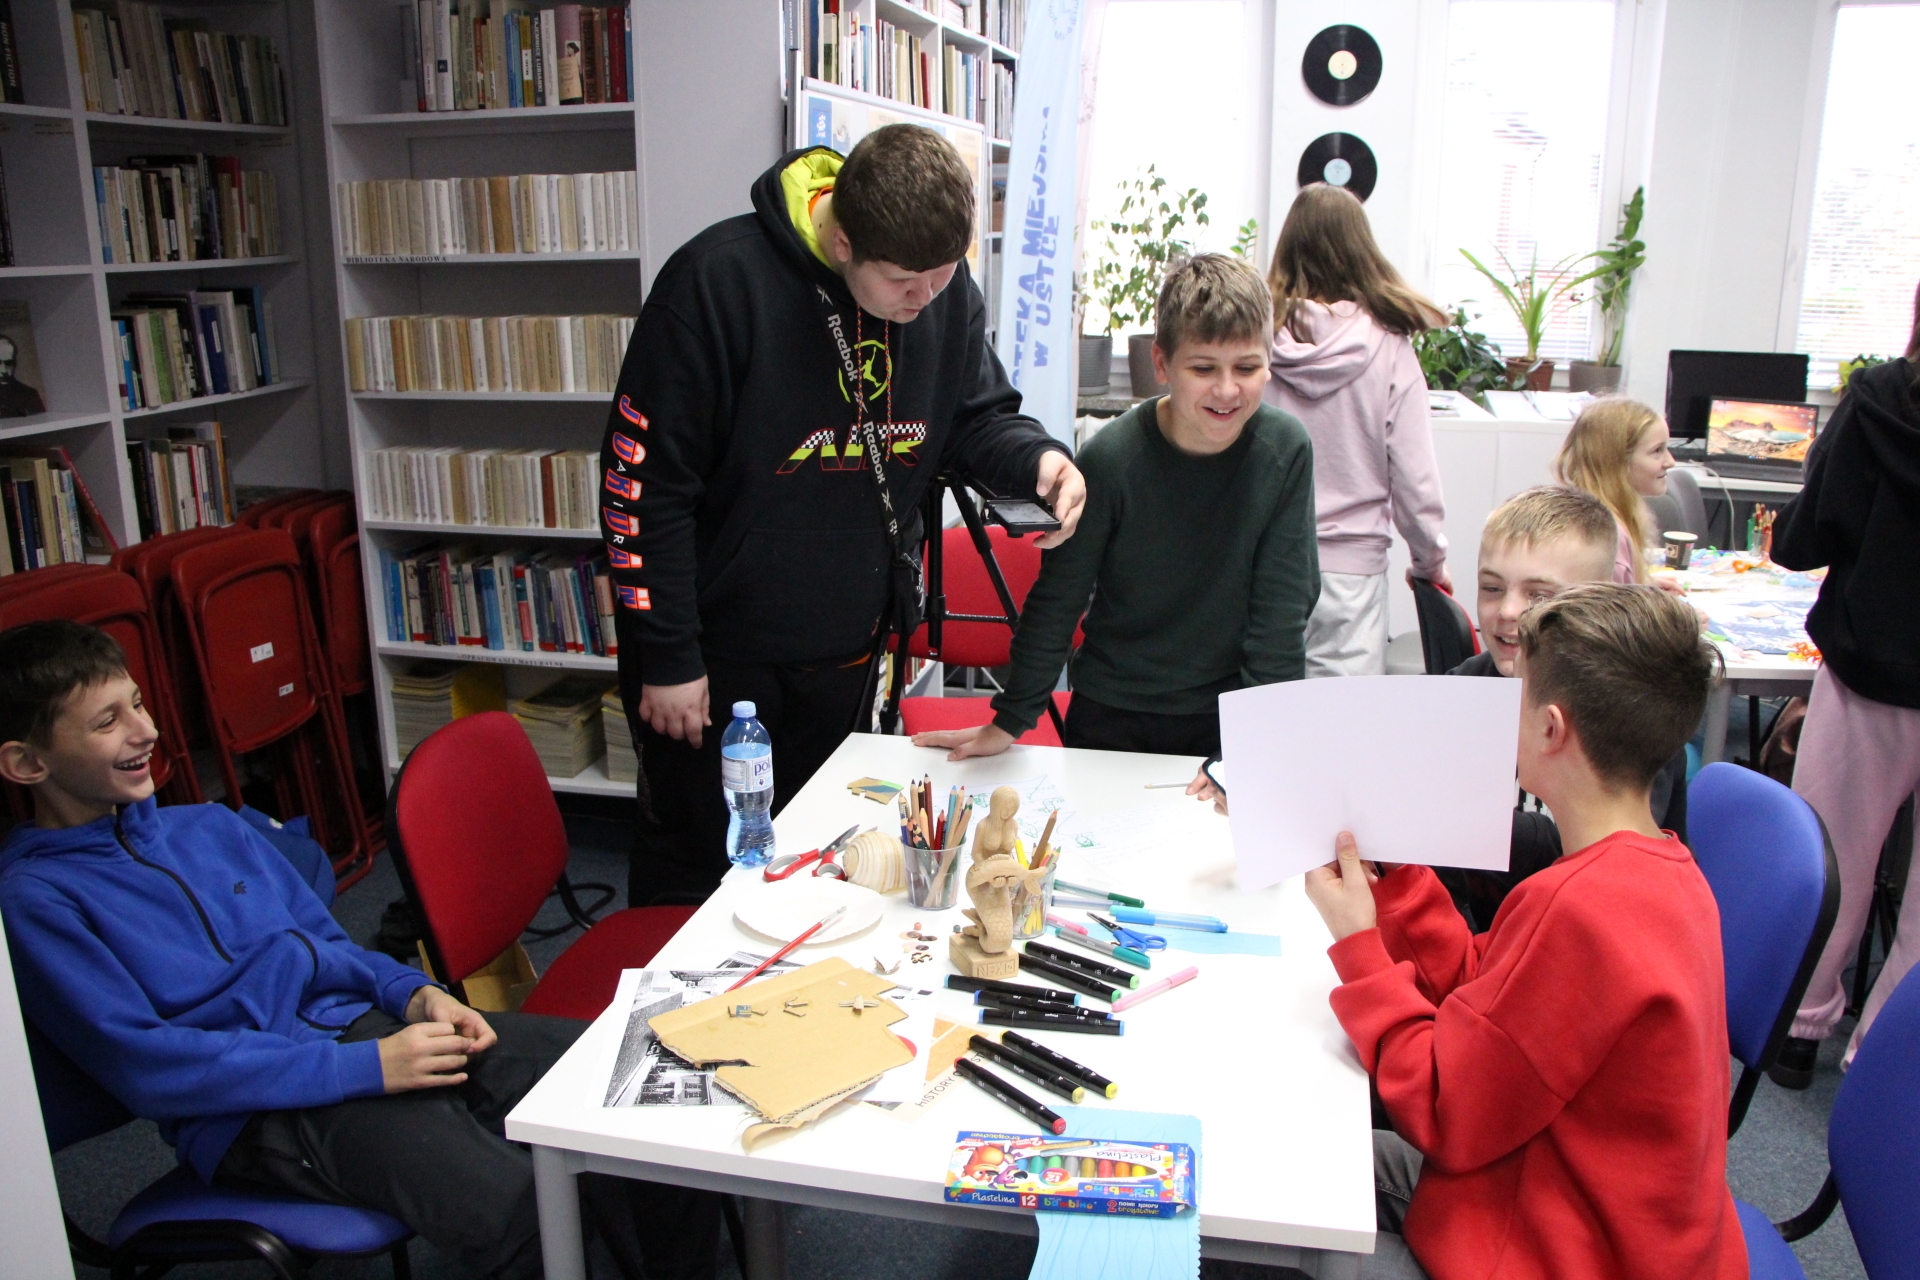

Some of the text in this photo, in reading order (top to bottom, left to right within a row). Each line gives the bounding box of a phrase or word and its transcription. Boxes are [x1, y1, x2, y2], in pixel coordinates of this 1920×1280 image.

[533, 16, 543, 93] TAJEMNICE LUBIANKI
[345, 255, 447, 264] BIBLIOTEKA NARODOWA
[827, 313, 859, 382] Reebok
[1033, 340, 1049, 367] W
[862, 420, 886, 484] Reebok
[603, 395, 651, 610] JORDAN
[914, 1076, 955, 1107] HISTORY
[1096, 1151, 1162, 1162] Plastelina
[1045, 1174, 1063, 1182] 12
[1084, 1184, 1155, 1197] bambino
[971, 1192, 1036, 1207] Plastelina 12
[1044, 1198, 1093, 1210] bambino
[1107, 1200, 1117, 1213] 2
